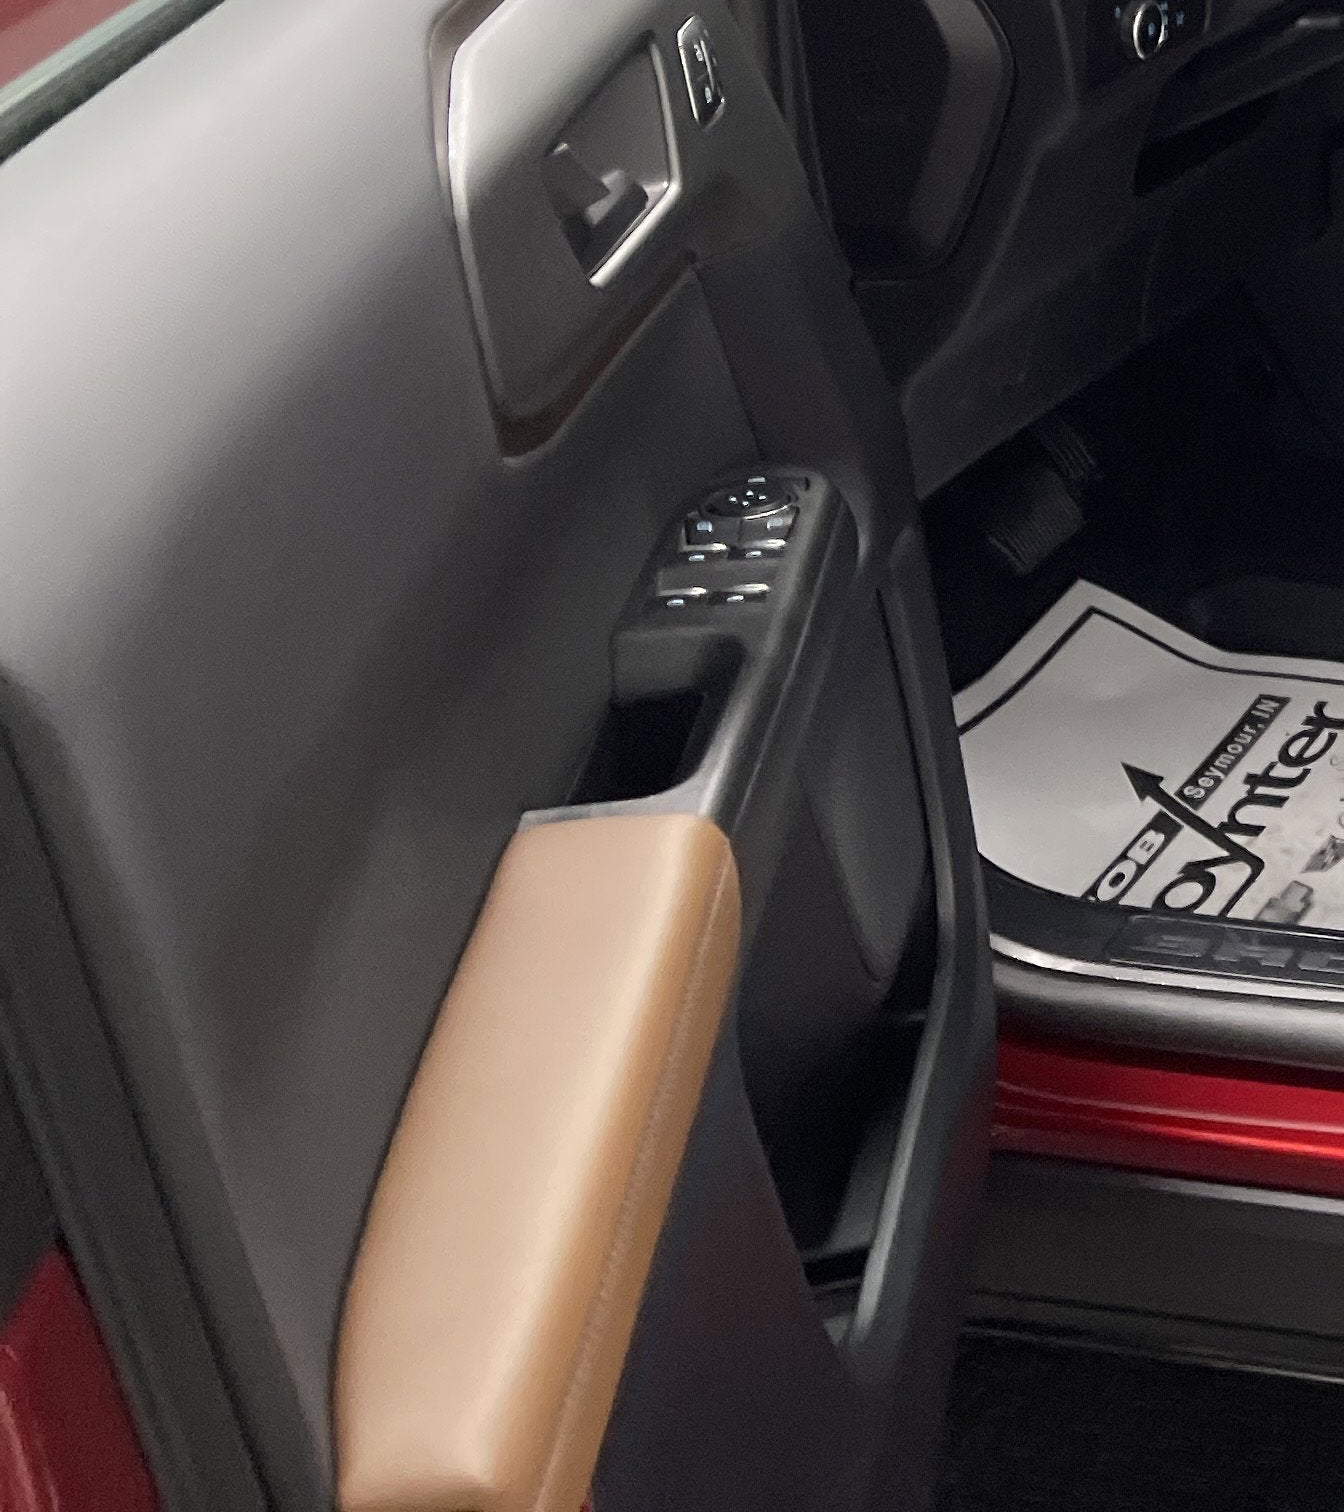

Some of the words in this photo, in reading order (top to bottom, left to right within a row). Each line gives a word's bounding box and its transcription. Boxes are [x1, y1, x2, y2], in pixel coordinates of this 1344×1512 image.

[1183, 724, 1266, 800] Seymour,
[1251, 697, 1281, 720] IN
[1087, 828, 1166, 903] OB
